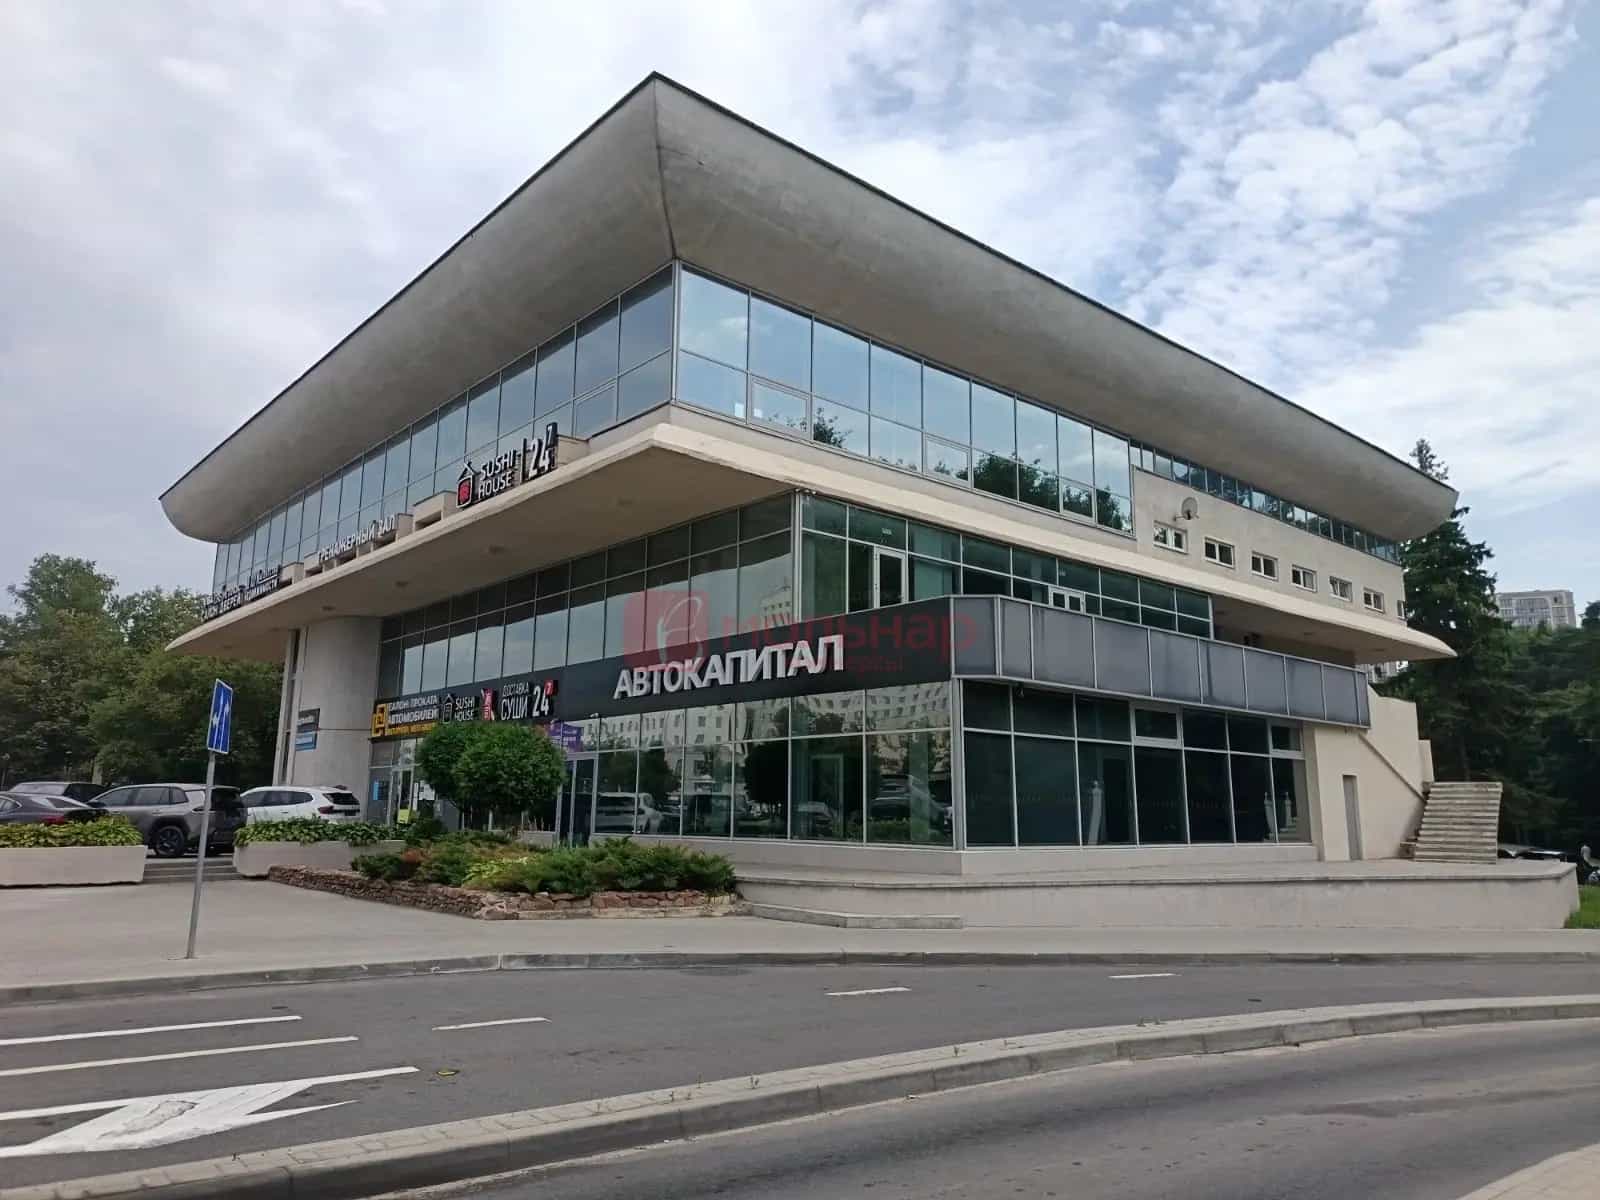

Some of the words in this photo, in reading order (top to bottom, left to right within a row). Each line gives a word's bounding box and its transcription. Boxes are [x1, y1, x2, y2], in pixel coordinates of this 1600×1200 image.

[480, 449, 515, 480] SUSHI
[528, 438, 550, 478] 24
[478, 471, 513, 499] HOUSE
[613, 634, 845, 700] АВТОКАПИТАЛ
[456, 696, 475, 710] SUSHI
[502, 681, 529, 697] ДОСТАВКА
[532, 686, 549, 717] 24
[455, 710, 474, 721] HOUSE
[501, 695, 528, 720] СУШИ
